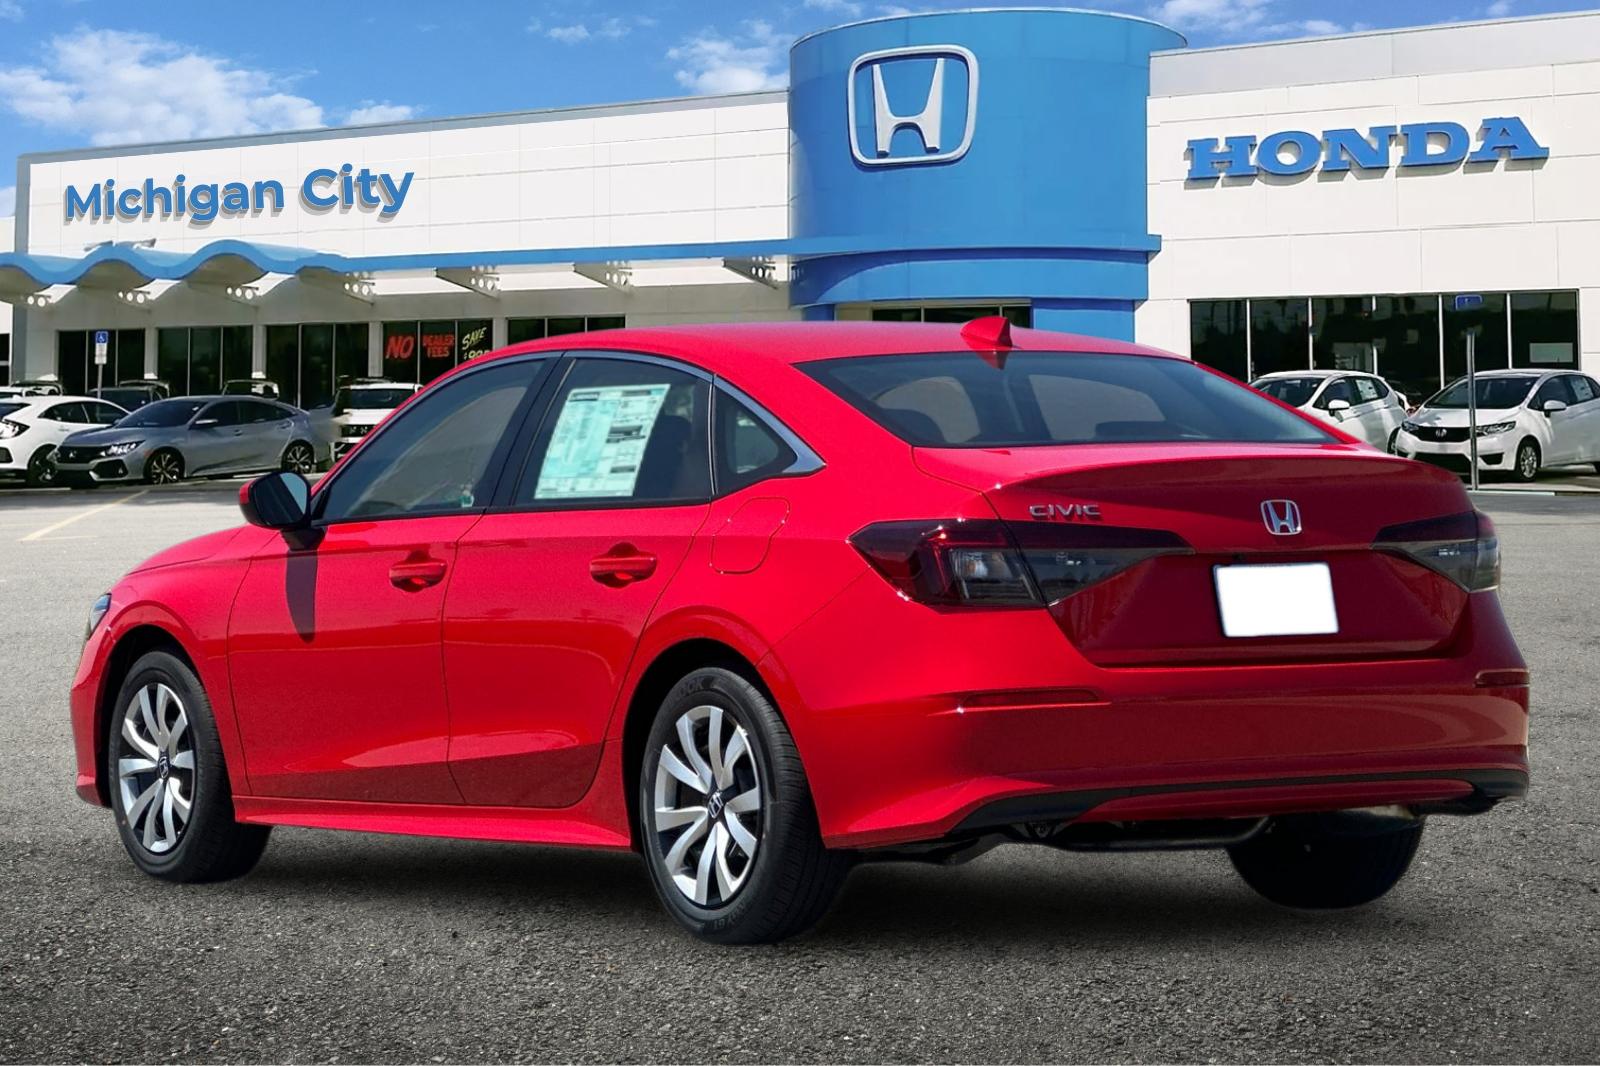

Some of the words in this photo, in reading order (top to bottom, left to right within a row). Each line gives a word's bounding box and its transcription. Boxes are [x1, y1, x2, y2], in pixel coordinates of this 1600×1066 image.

[1185, 116, 1550, 182] HONDA
[65, 173, 284, 223] Michigan
[302, 162, 414, 215] City
[386, 335, 415, 359] NO
[462, 327, 487, 350] SAVE
[1029, 503, 1101, 517] CIVIC
